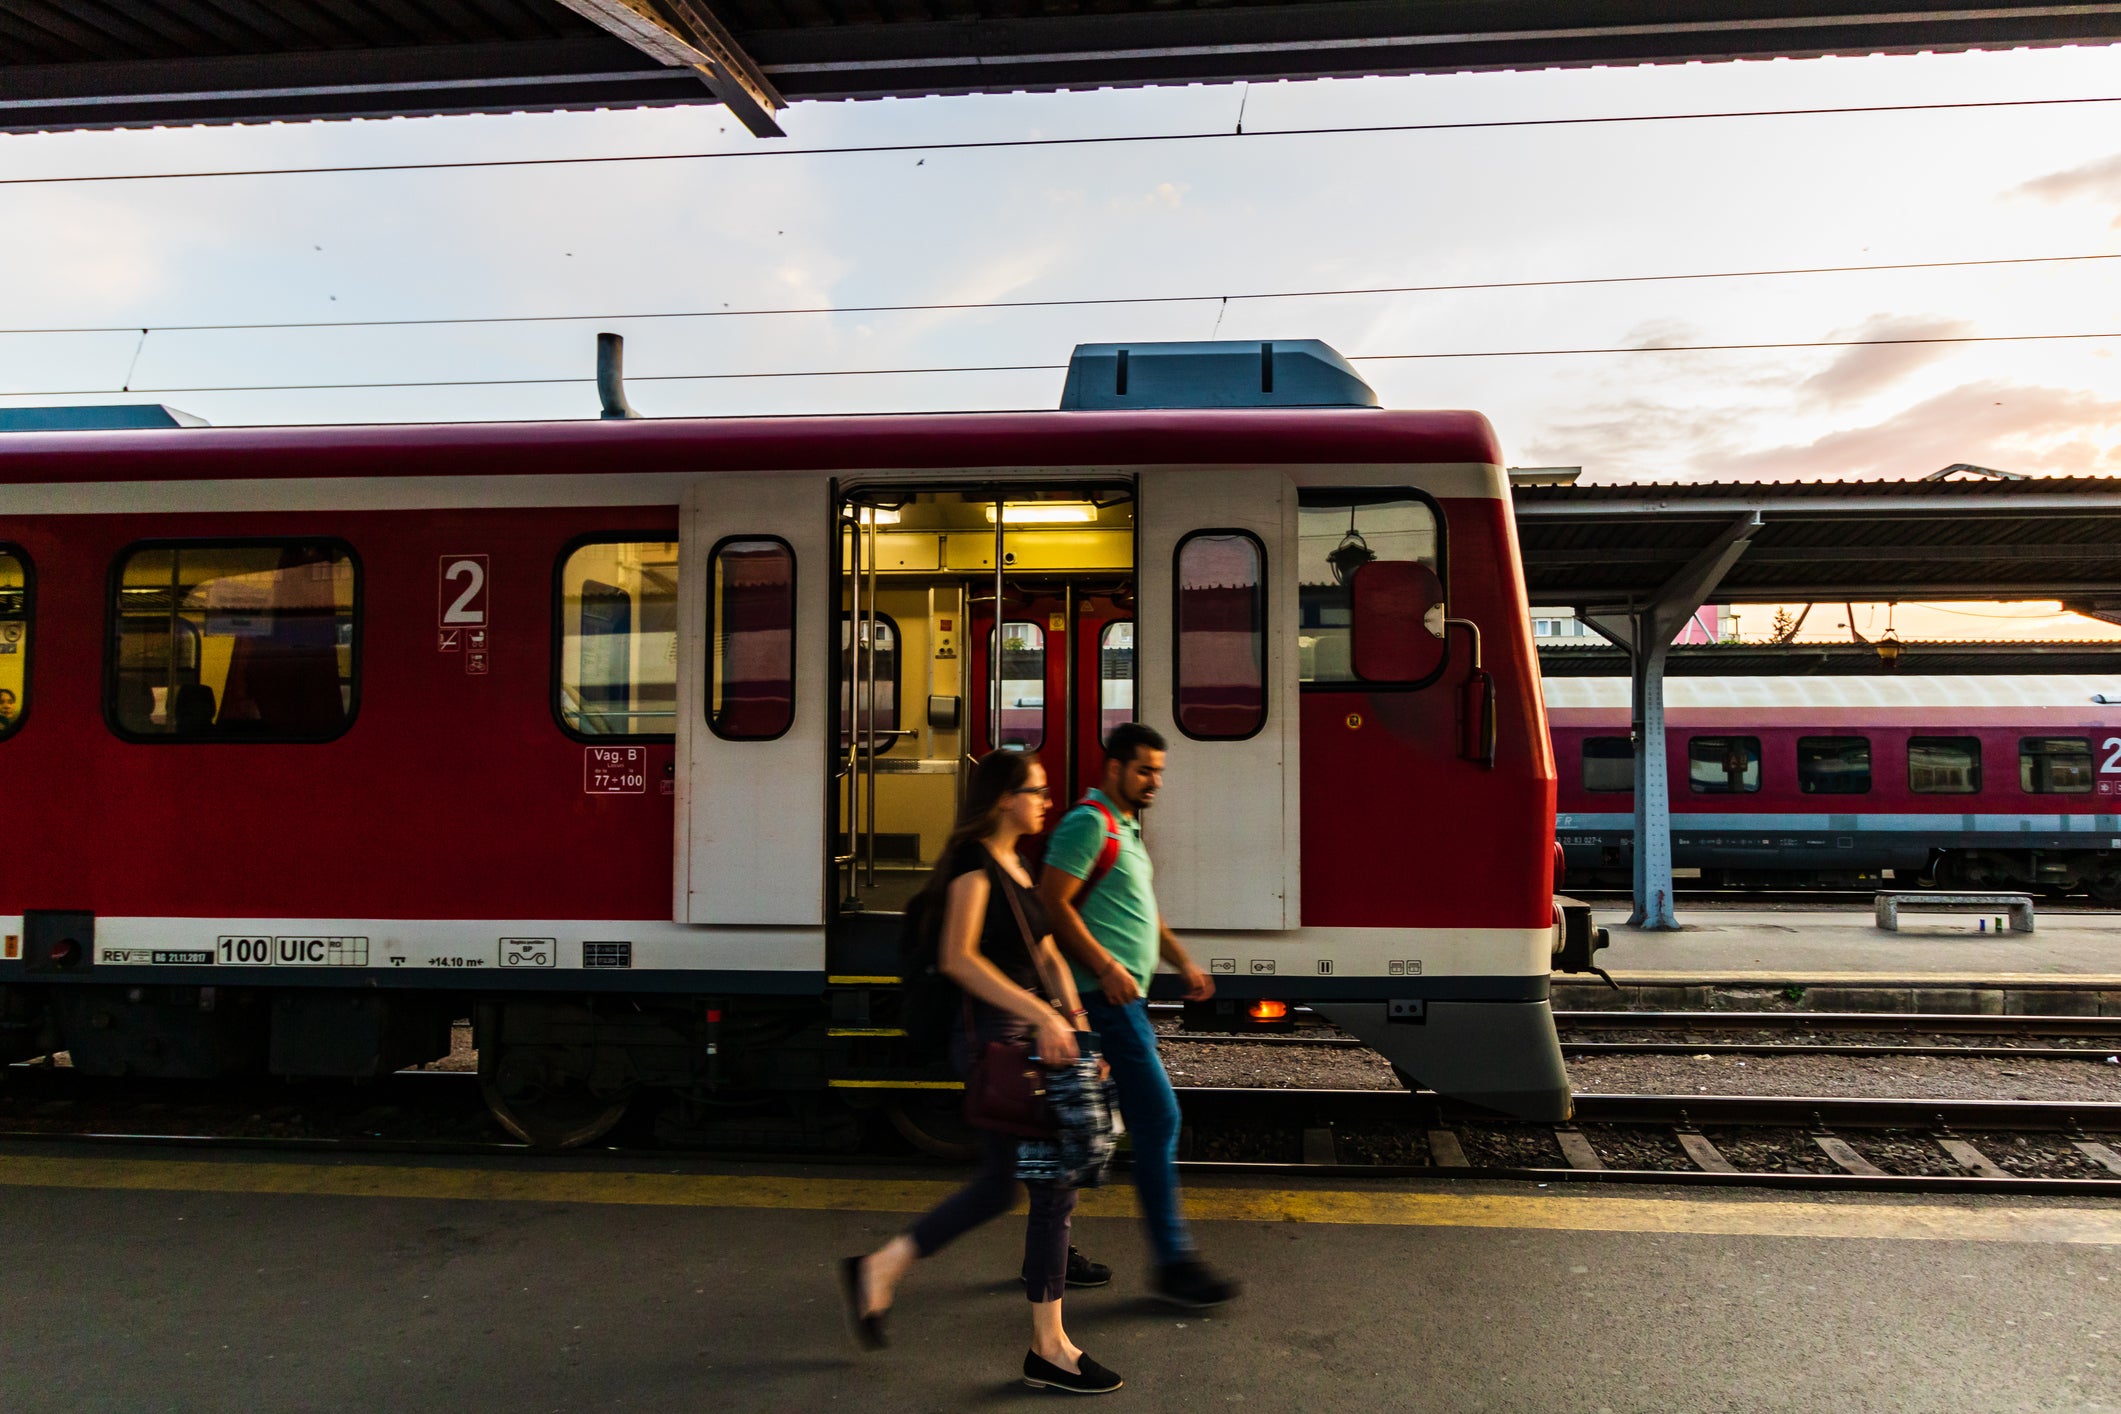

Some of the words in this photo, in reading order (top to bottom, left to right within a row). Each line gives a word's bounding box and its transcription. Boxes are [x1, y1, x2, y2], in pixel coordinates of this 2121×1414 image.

[443, 560, 484, 623] 2
[594, 749, 623, 764] Vag.
[628, 749, 637, 761] B
[2100, 737, 2121, 773] 2
[103, 951, 131, 962] REV
[221, 939, 268, 963] 100
[280, 940, 324, 962] UIC
[435, 957, 463, 967] 14.10
[466, 958, 477, 967] m
